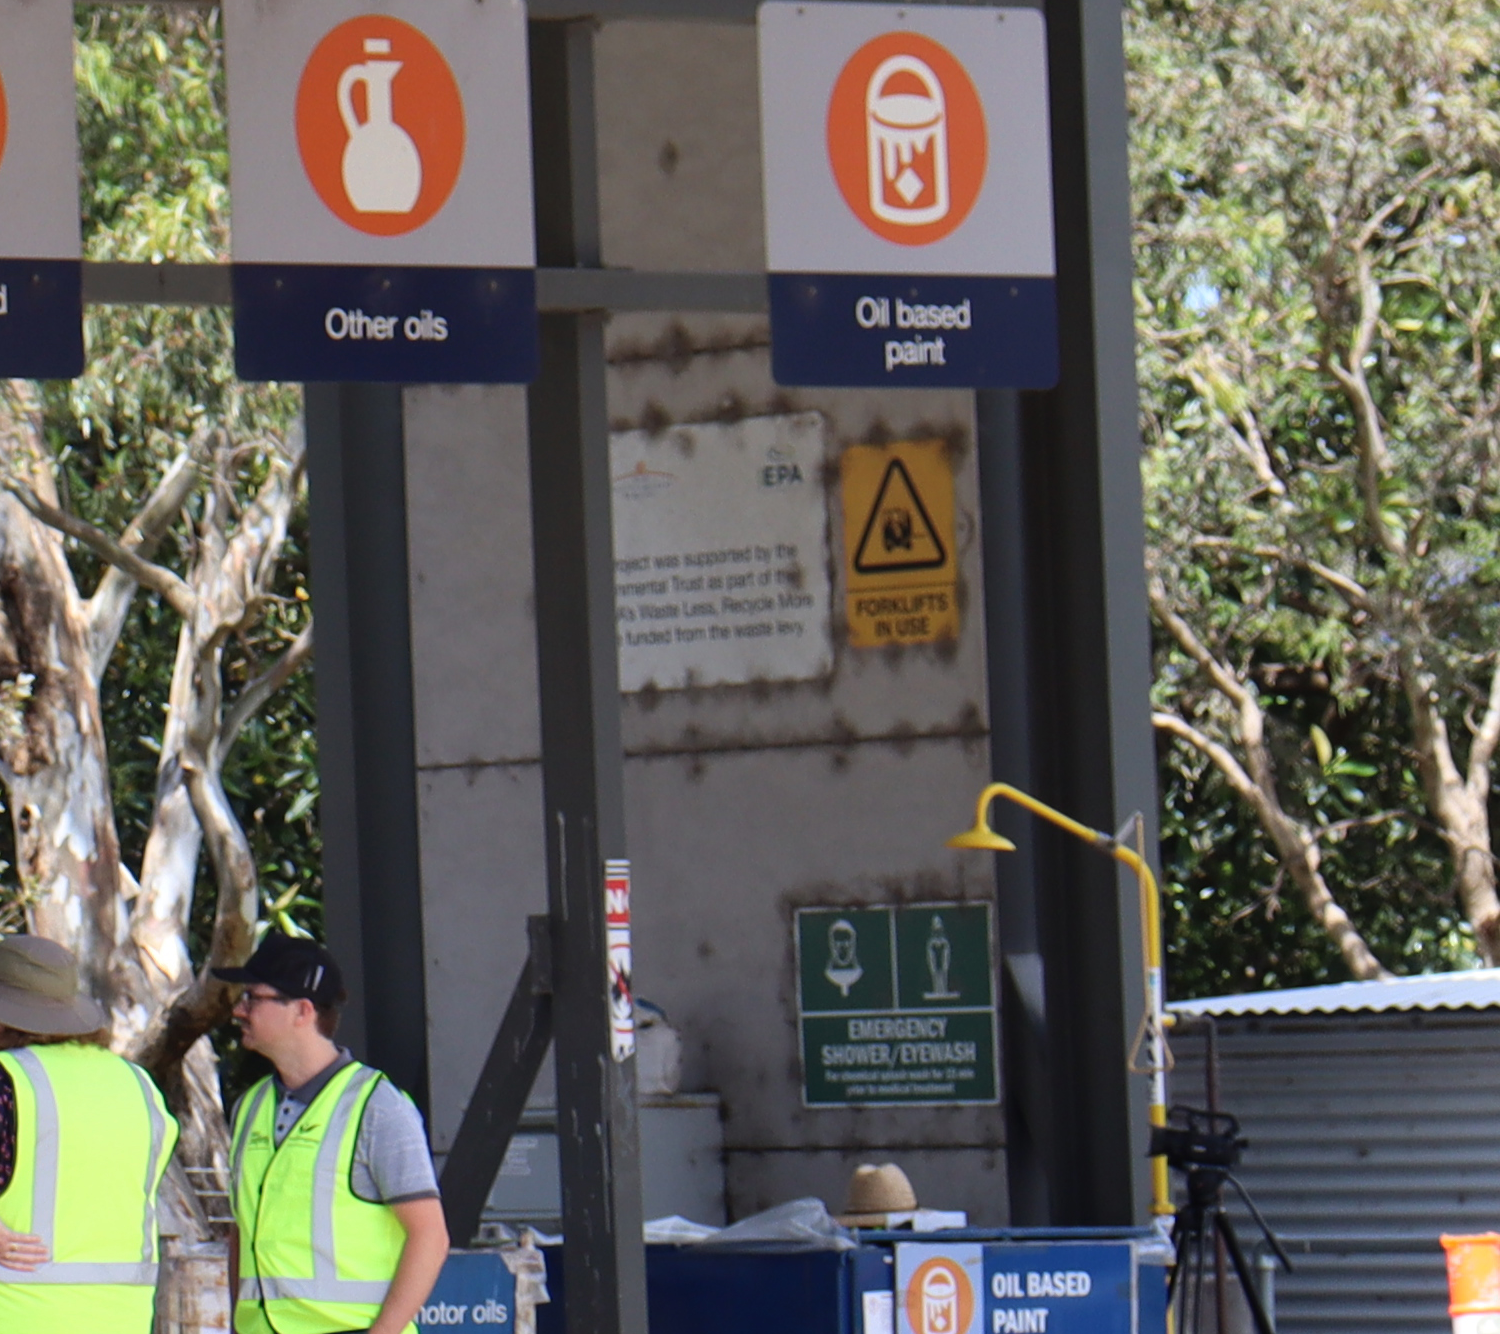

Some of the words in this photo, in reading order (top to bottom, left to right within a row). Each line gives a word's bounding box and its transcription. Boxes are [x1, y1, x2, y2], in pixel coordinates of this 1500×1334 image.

[325, 307, 398, 340] Other
[404, 309, 448, 341] oils
[855, 296, 890, 328] Oil
[895, 297, 971, 329] based
[885, 333, 946, 372] paint
[762, 465, 804, 487] EPA
[653, 555, 679, 568] was
[683, 547, 752, 567] supported
[754, 545, 771, 563] by
[775, 544, 797, 558] the
[672, 575, 704, 591] Trust
[708, 577, 723, 588] as
[726, 573, 754, 590] part
[758, 570, 771, 585] of
[640, 604, 679, 619] Waste
[721, 596, 775, 615] Recycle
[778, 594, 814, 608] More
[856, 593, 948, 616] FORKLIFTS
[626, 630, 671, 646] funded
[675, 627, 705, 642] from
[709, 625, 730, 640] the
[733, 622, 773, 637] waste
[875, 620, 891, 637] IN
[896, 616, 929, 636] USE
[848, 1018, 947, 1040] EMERGENCY
[821, 1041, 976, 1067] SHOWER/EYEWASH
[992, 1272, 1024, 1298] OIL
[1027, 1271, 1091, 1297] BASED
[473, 1302, 507, 1324] oils
[992, 1308, 1048, 1334] PAINT
